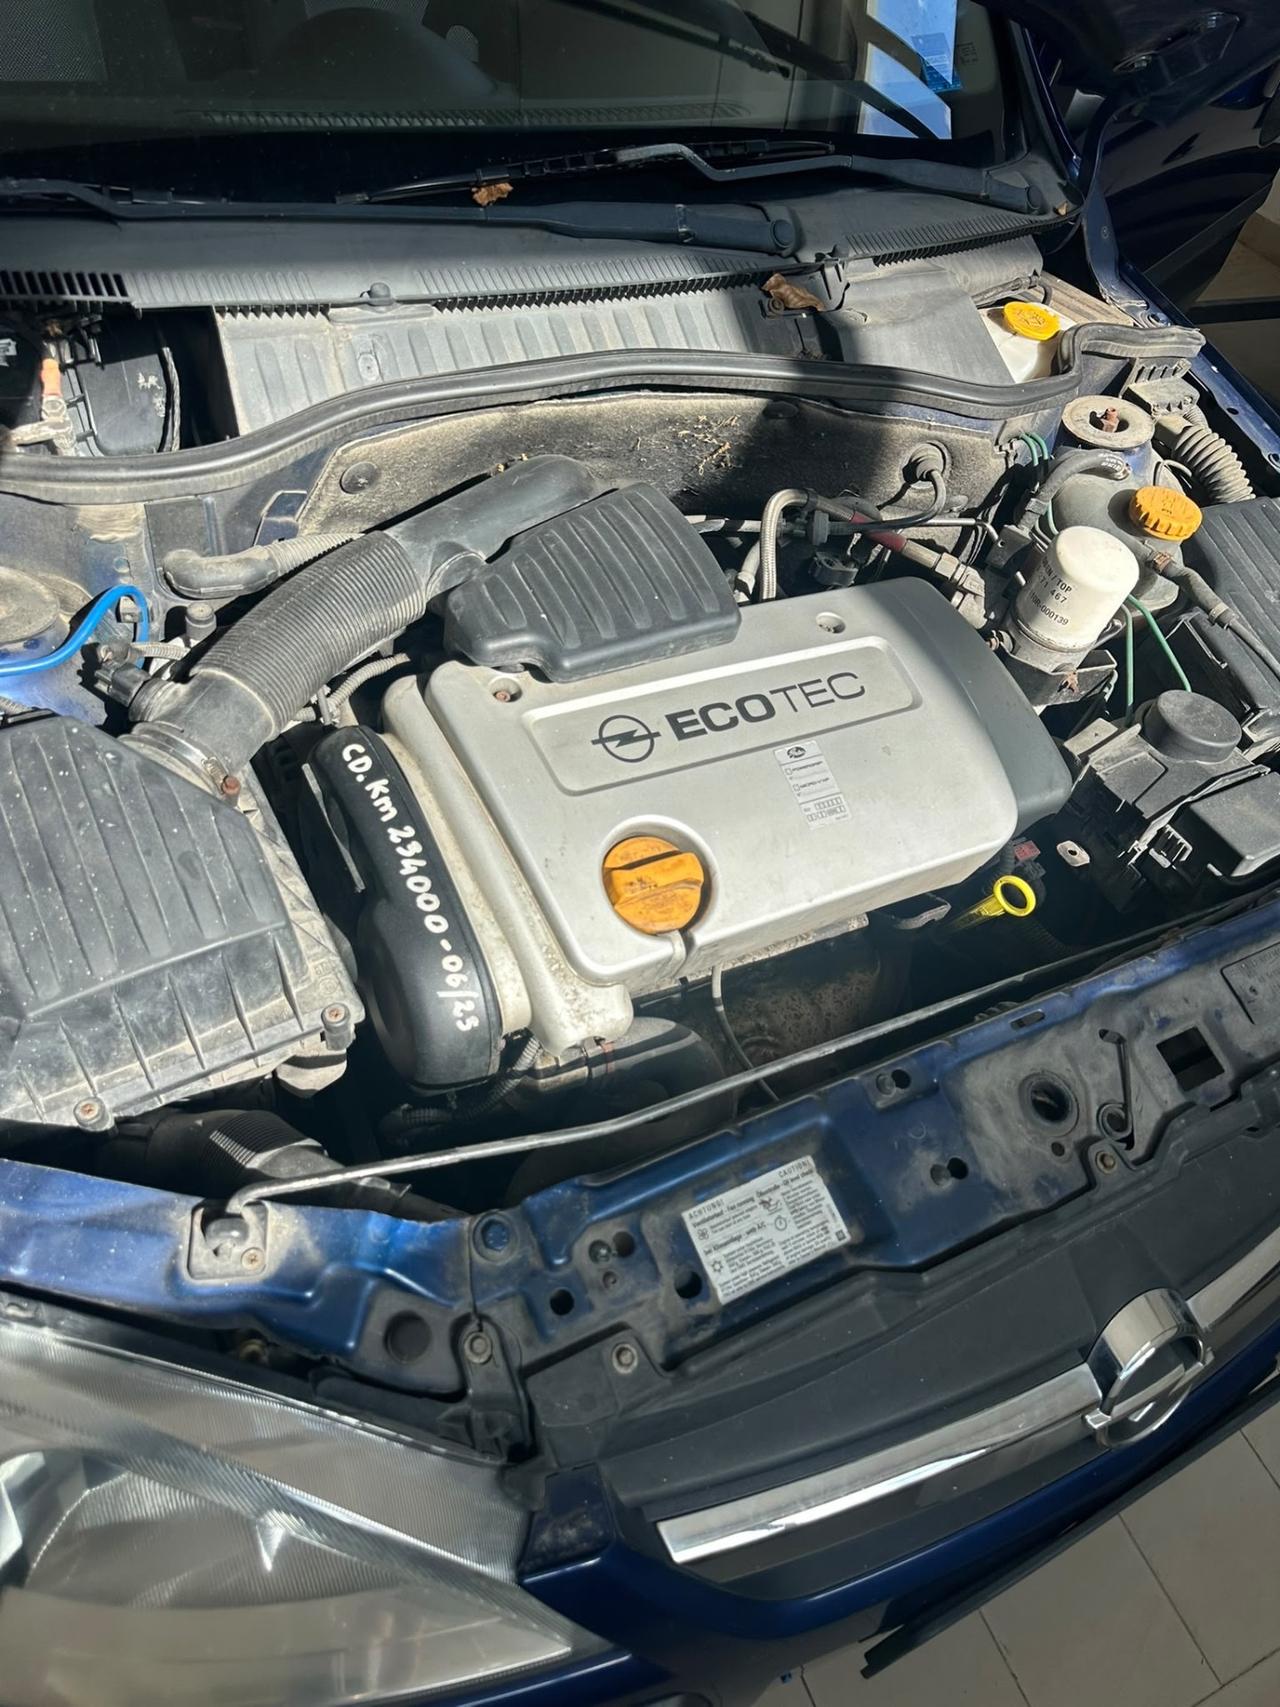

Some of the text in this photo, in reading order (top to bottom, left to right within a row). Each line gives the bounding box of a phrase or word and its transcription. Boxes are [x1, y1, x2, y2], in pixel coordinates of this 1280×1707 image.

[1056, 579, 1072, 593] TOP
[1050, 589, 1067, 603] 467
[665, 672, 865, 741] ECOTEC
